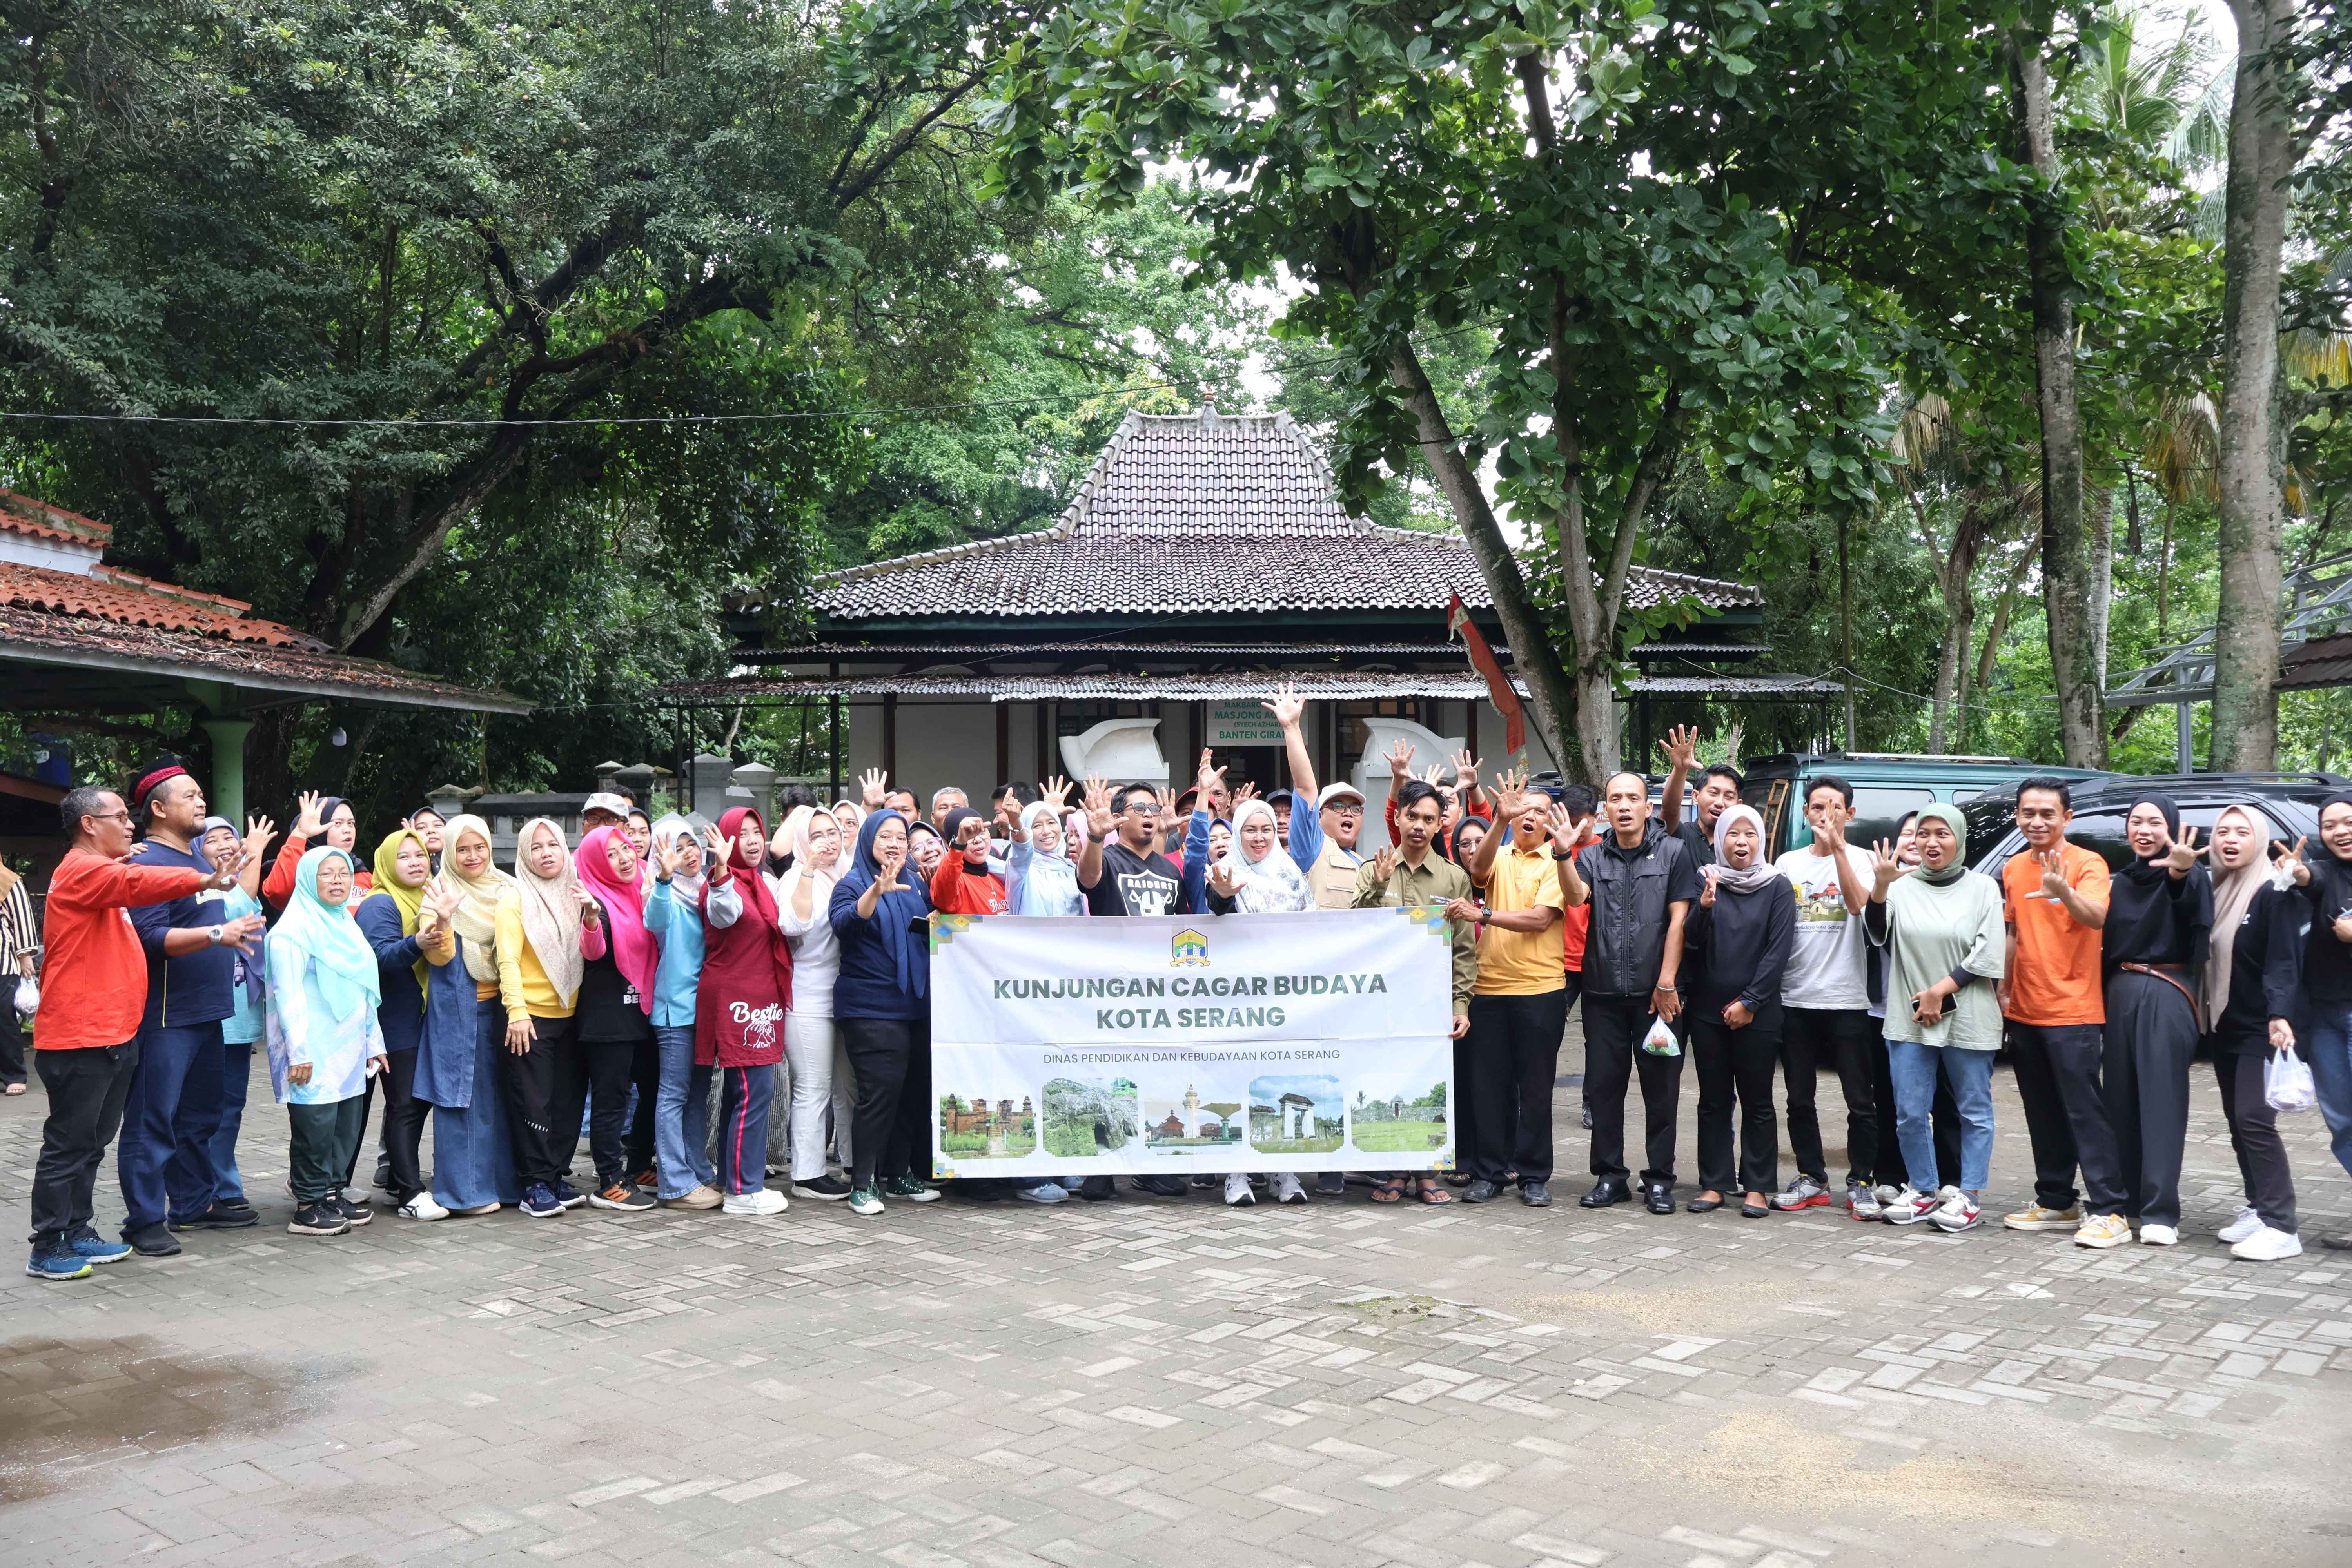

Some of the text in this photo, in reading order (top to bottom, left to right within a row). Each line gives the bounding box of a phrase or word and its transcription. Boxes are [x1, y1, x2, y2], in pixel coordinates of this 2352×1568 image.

[1127, 878, 1173, 891] RAIDERS
[994, 974, 1387, 999] KUNJUNGAN CAGAR BUDAYA
[729, 1001, 783, 1023] Bestie
[1097, 1007, 1285, 1029] KOTA SERANG
[1044, 1050, 1340, 1063] DINAS PENDIDIKAN DAN KEBUDAYAAN KOTA SERANG
